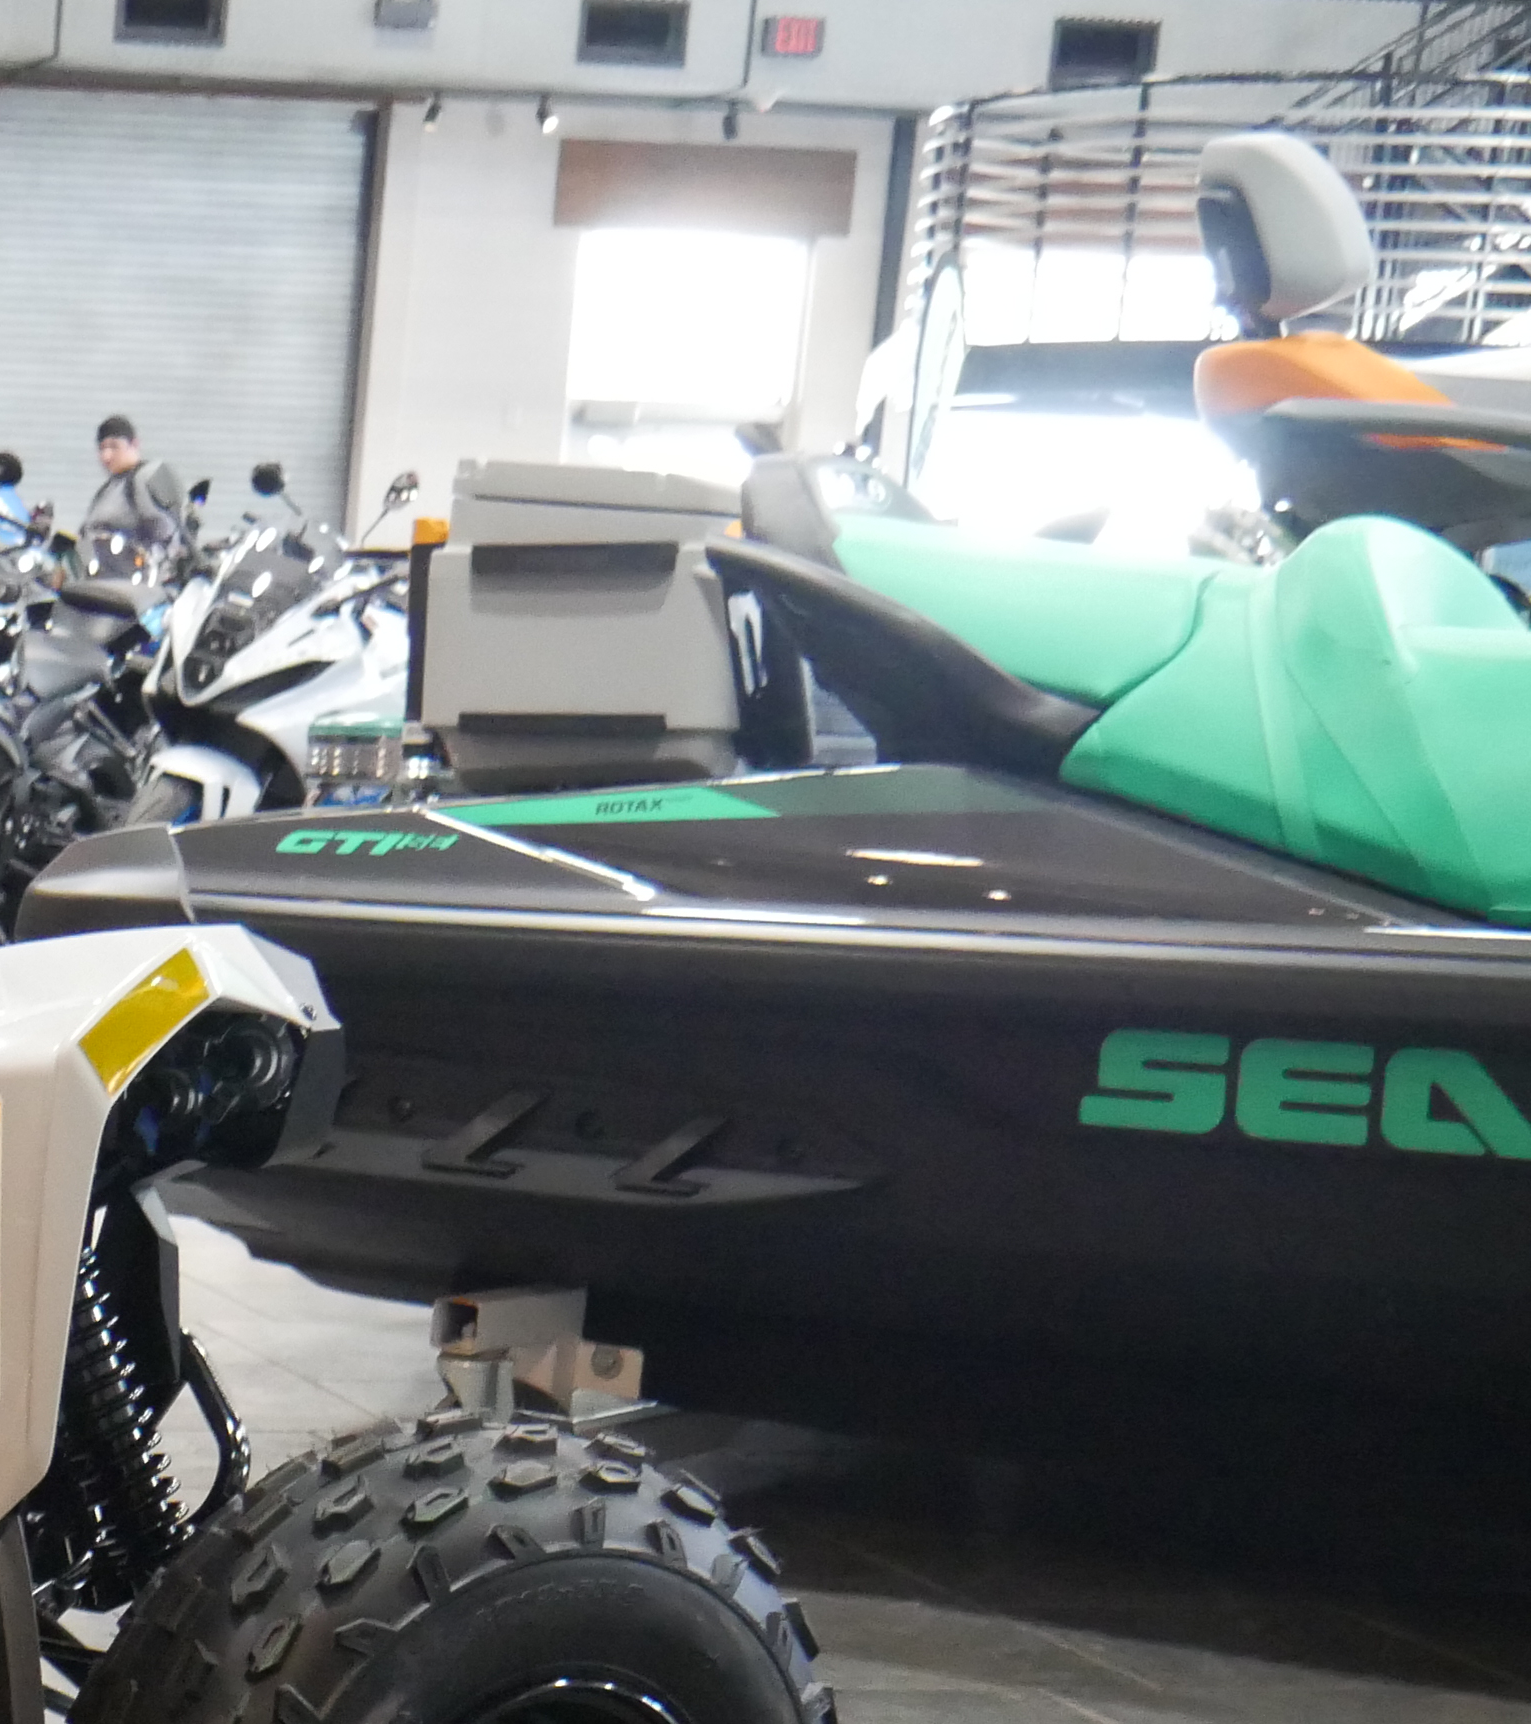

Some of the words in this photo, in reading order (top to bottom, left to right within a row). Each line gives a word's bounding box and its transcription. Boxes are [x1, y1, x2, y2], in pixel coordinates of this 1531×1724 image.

[775, 18, 817, 53] EXIT
[595, 798, 664, 816] ROTAX
[275, 828, 404, 857] GTI
[1077, 1026, 1531, 1161] SEA
